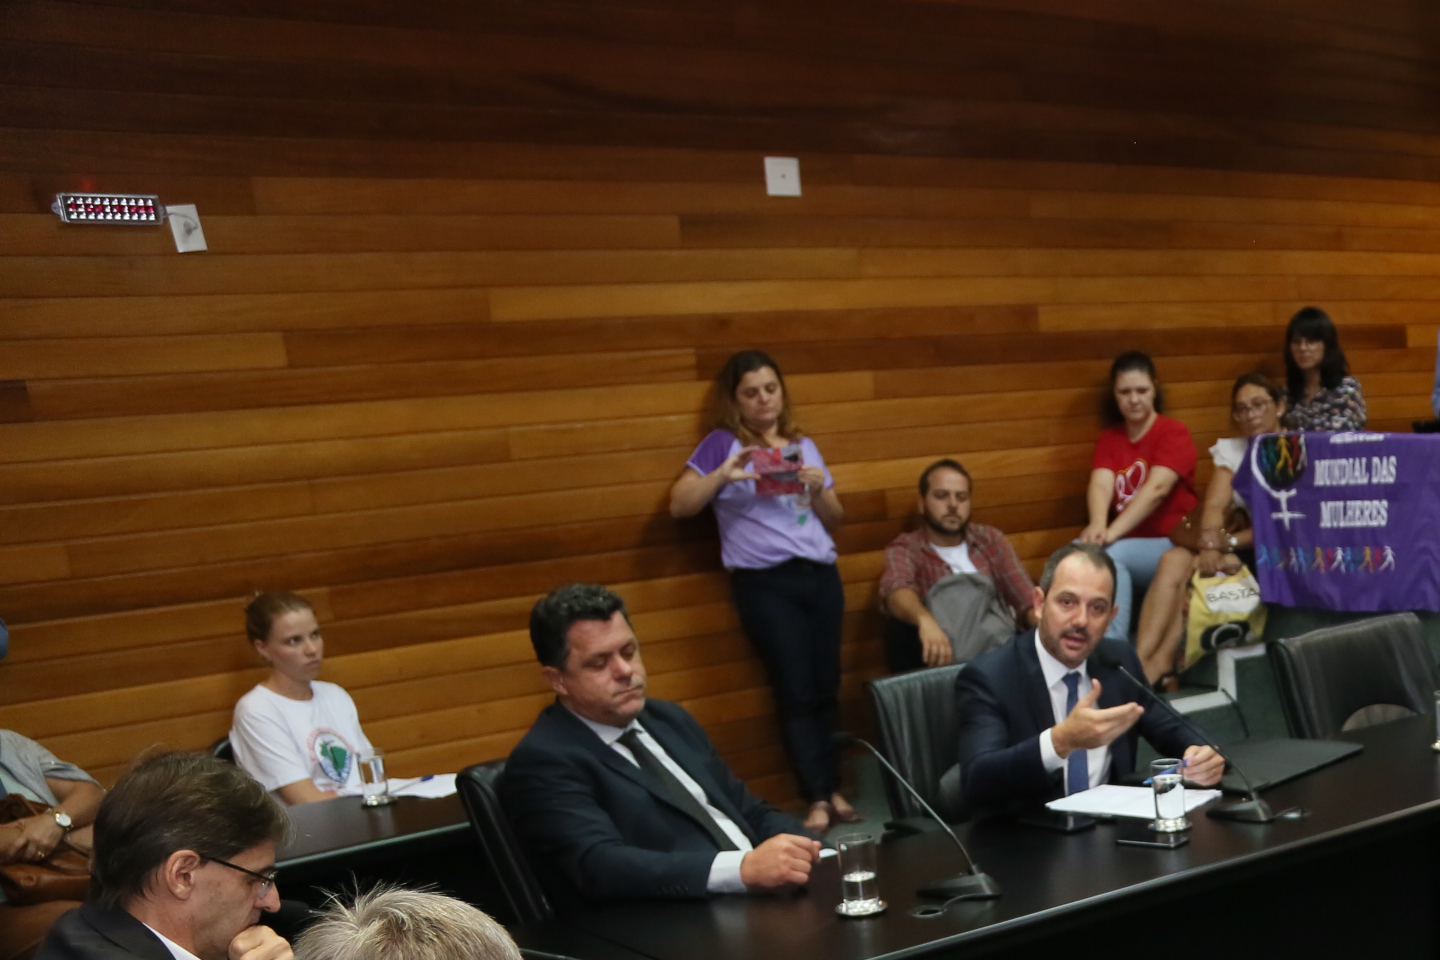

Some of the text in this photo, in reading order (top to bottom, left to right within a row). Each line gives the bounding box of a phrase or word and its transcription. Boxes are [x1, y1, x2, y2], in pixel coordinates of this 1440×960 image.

[1314, 455, 1397, 486] MUNDIAL DAS
[1320, 499, 1388, 528] MULHERES
[1207, 588, 1260, 602] BASTA
